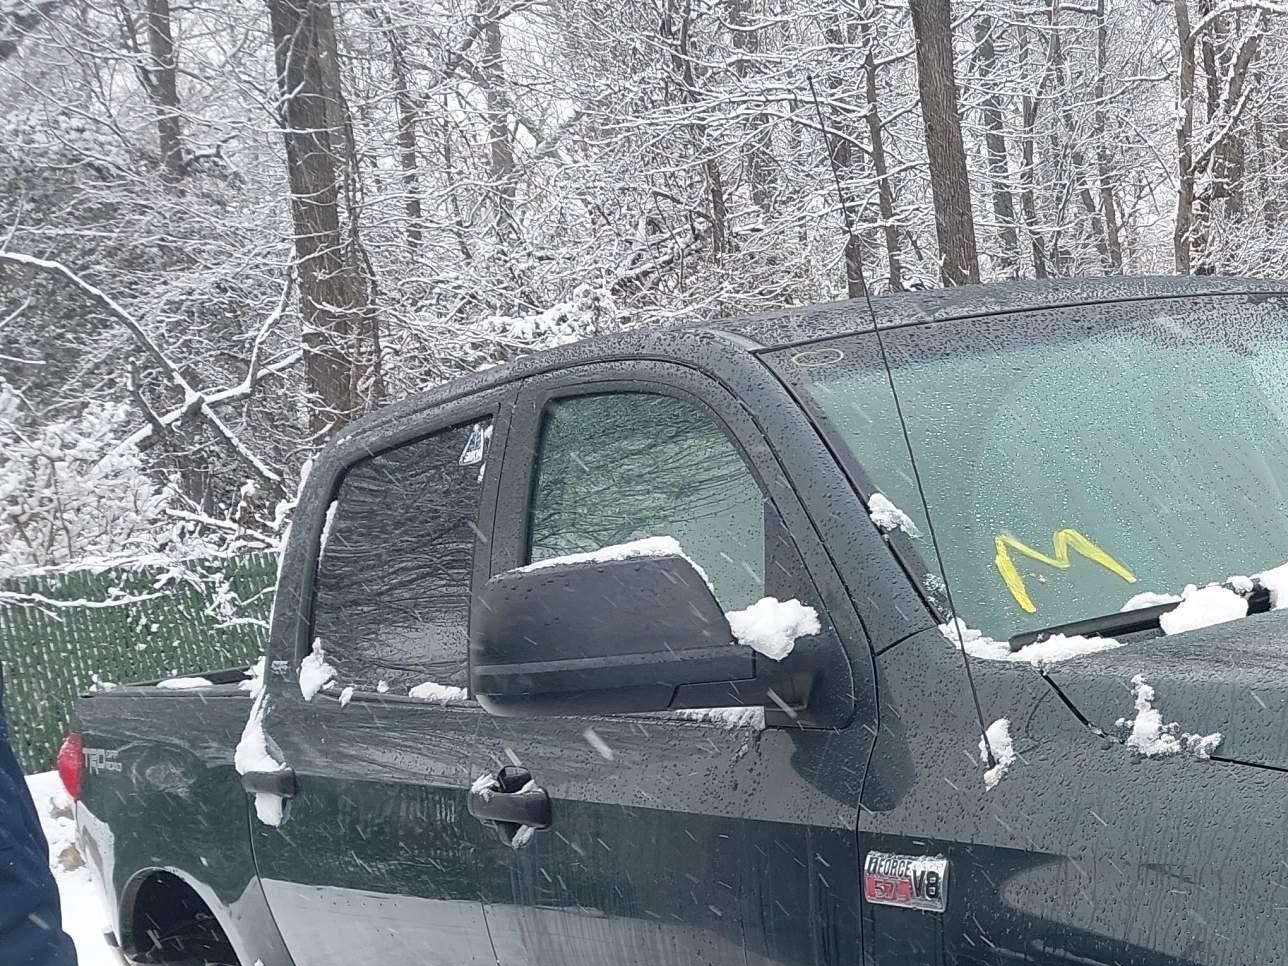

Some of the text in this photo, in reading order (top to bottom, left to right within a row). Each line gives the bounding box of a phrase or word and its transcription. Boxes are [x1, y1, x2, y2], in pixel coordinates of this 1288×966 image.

[994, 528, 1137, 614] M
[82, 747, 106, 775] TRD
[911, 868, 940, 899] V8
